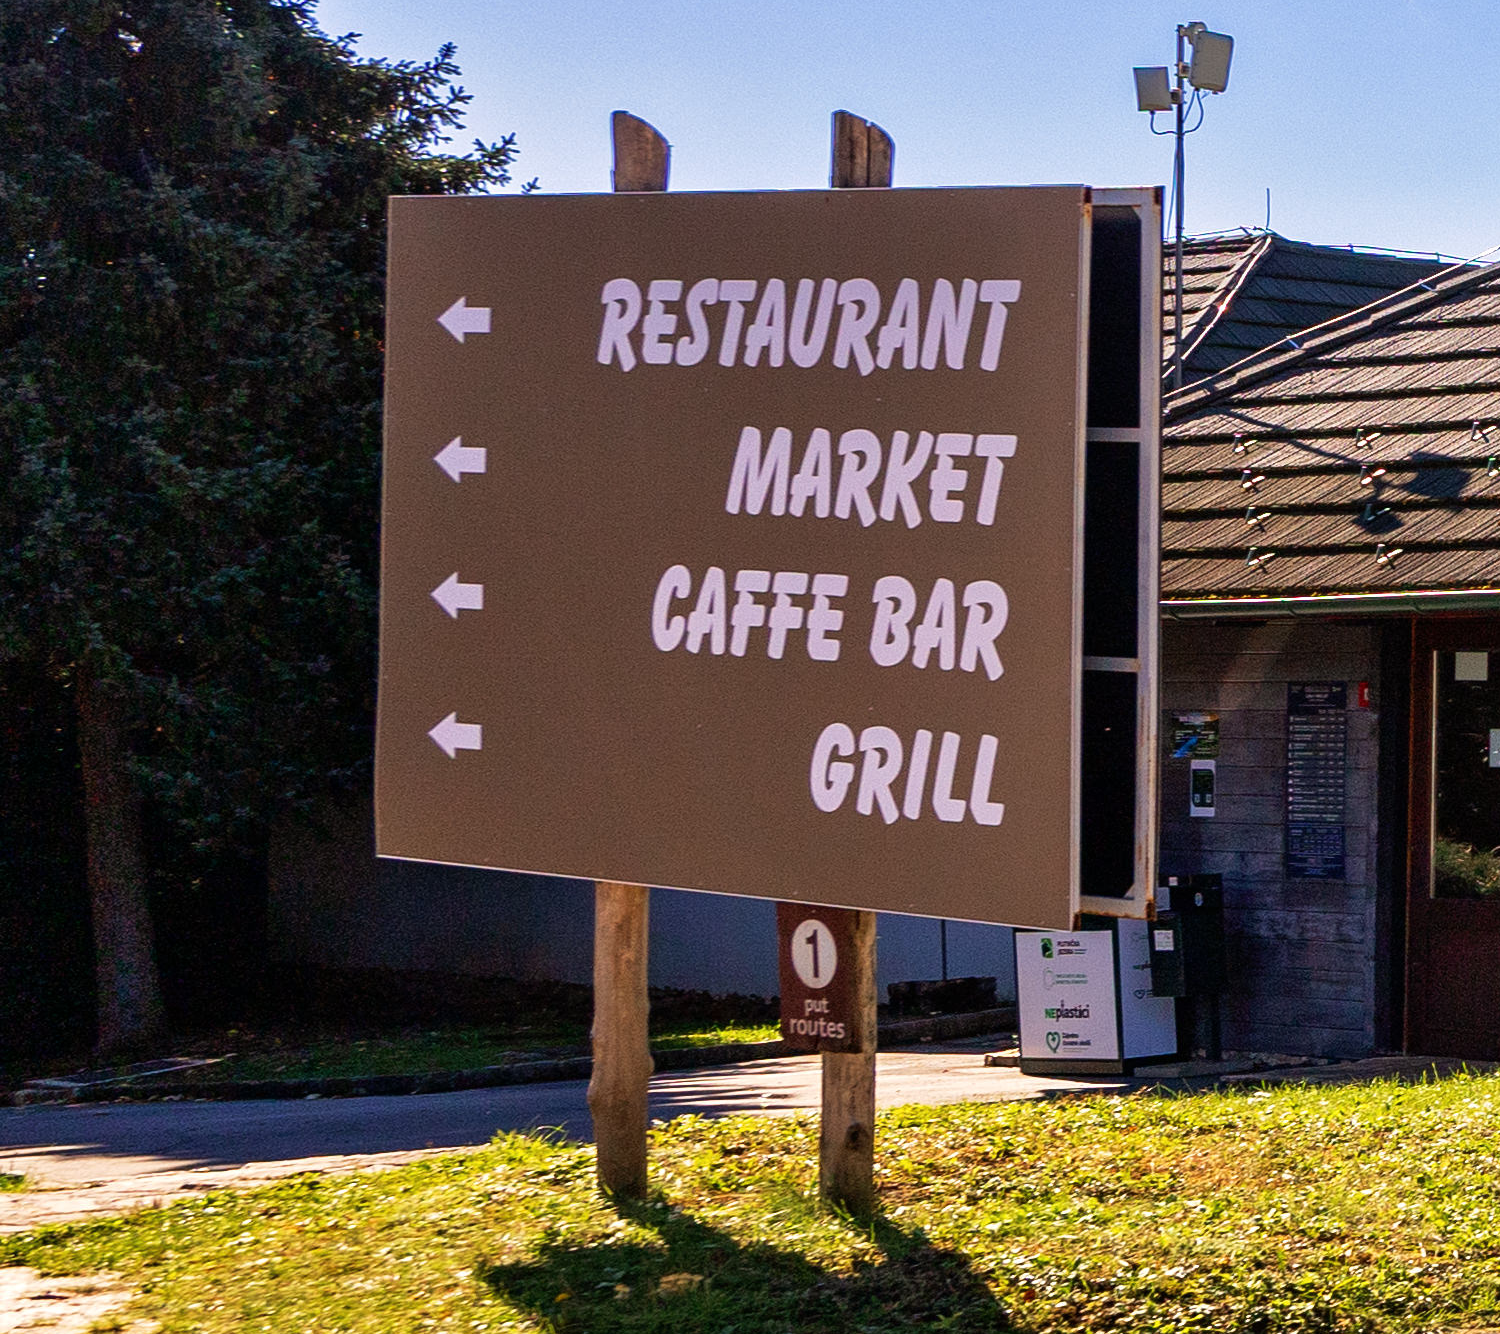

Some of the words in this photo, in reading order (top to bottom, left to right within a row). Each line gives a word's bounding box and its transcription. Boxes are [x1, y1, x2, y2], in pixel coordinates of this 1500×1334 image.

[597, 278, 1022, 376] RESTAURANT
[725, 426, 1018, 529] MARKET
[652, 564, 849, 661] CAFFE
[869, 575, 1010, 681] BAR
[810, 722, 1005, 826] GRILL
[805, 929, 820, 979] 1
[789, 1017, 846, 1039] routes
[804, 998, 831, 1017] put
